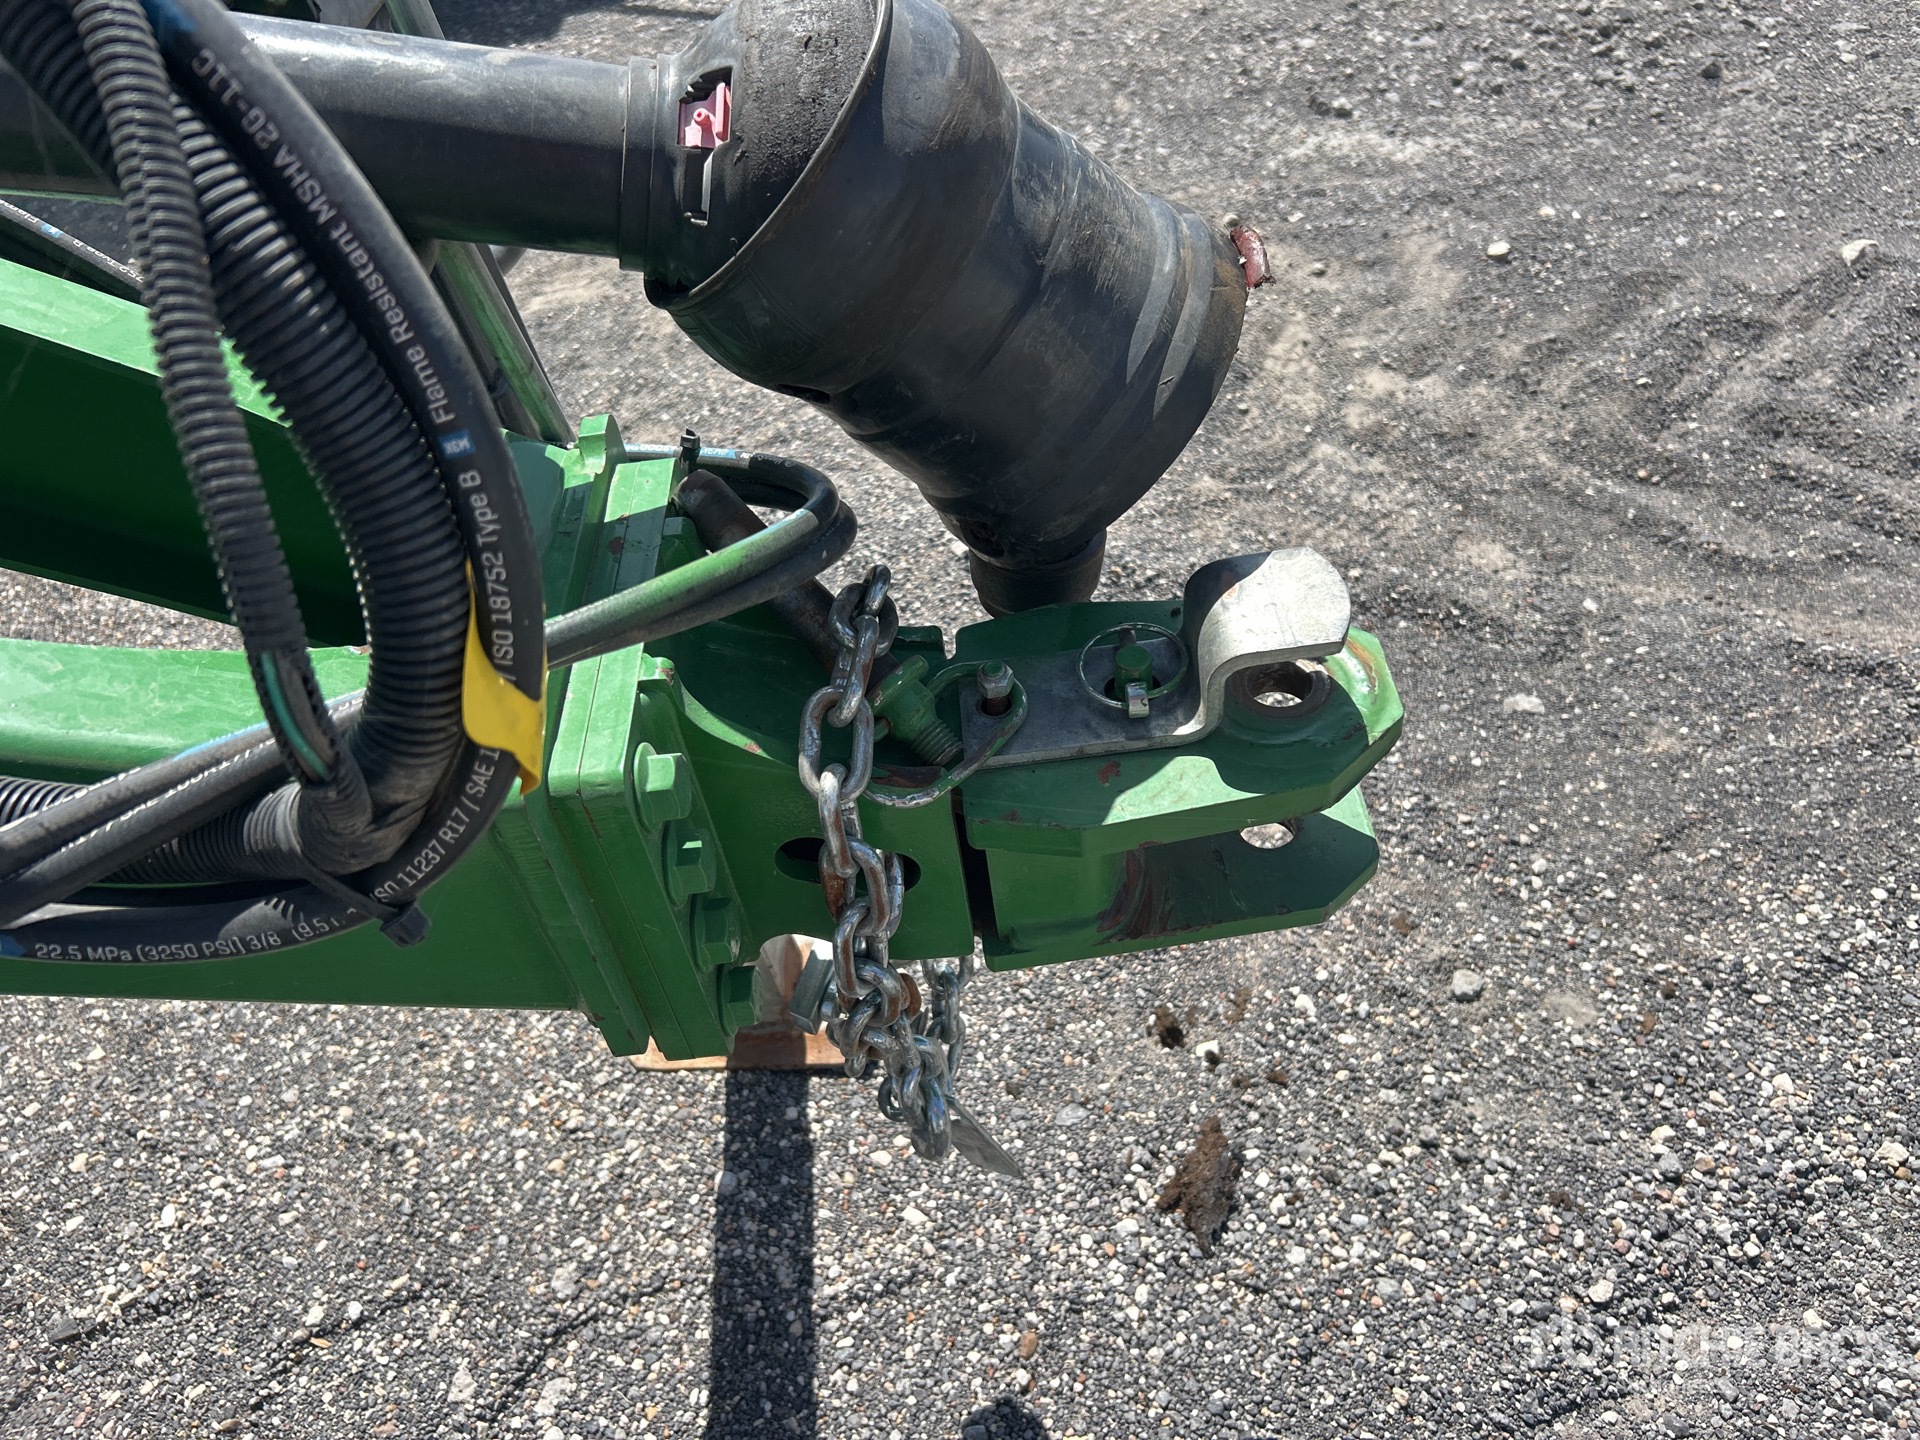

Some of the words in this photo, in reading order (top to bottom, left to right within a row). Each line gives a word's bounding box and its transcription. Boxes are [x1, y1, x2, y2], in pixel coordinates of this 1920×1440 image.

[273, 144, 337, 225] MSHA
[329, 220, 415, 344] Resistant
[405, 344, 456, 424] Flame
[458, 468, 482, 489] B
[469, 492, 502, 547] Type
[481, 553, 513, 624] 18752
[491, 625, 514, 665] ISO
[397, 839, 446, 887] 11237
[438, 806, 470, 844] R17
[465, 761, 496, 798] SAE
[34, 942, 83, 961] 22.5
[86, 946, 134, 961] MPa
[136, 943, 200, 962] (3250
